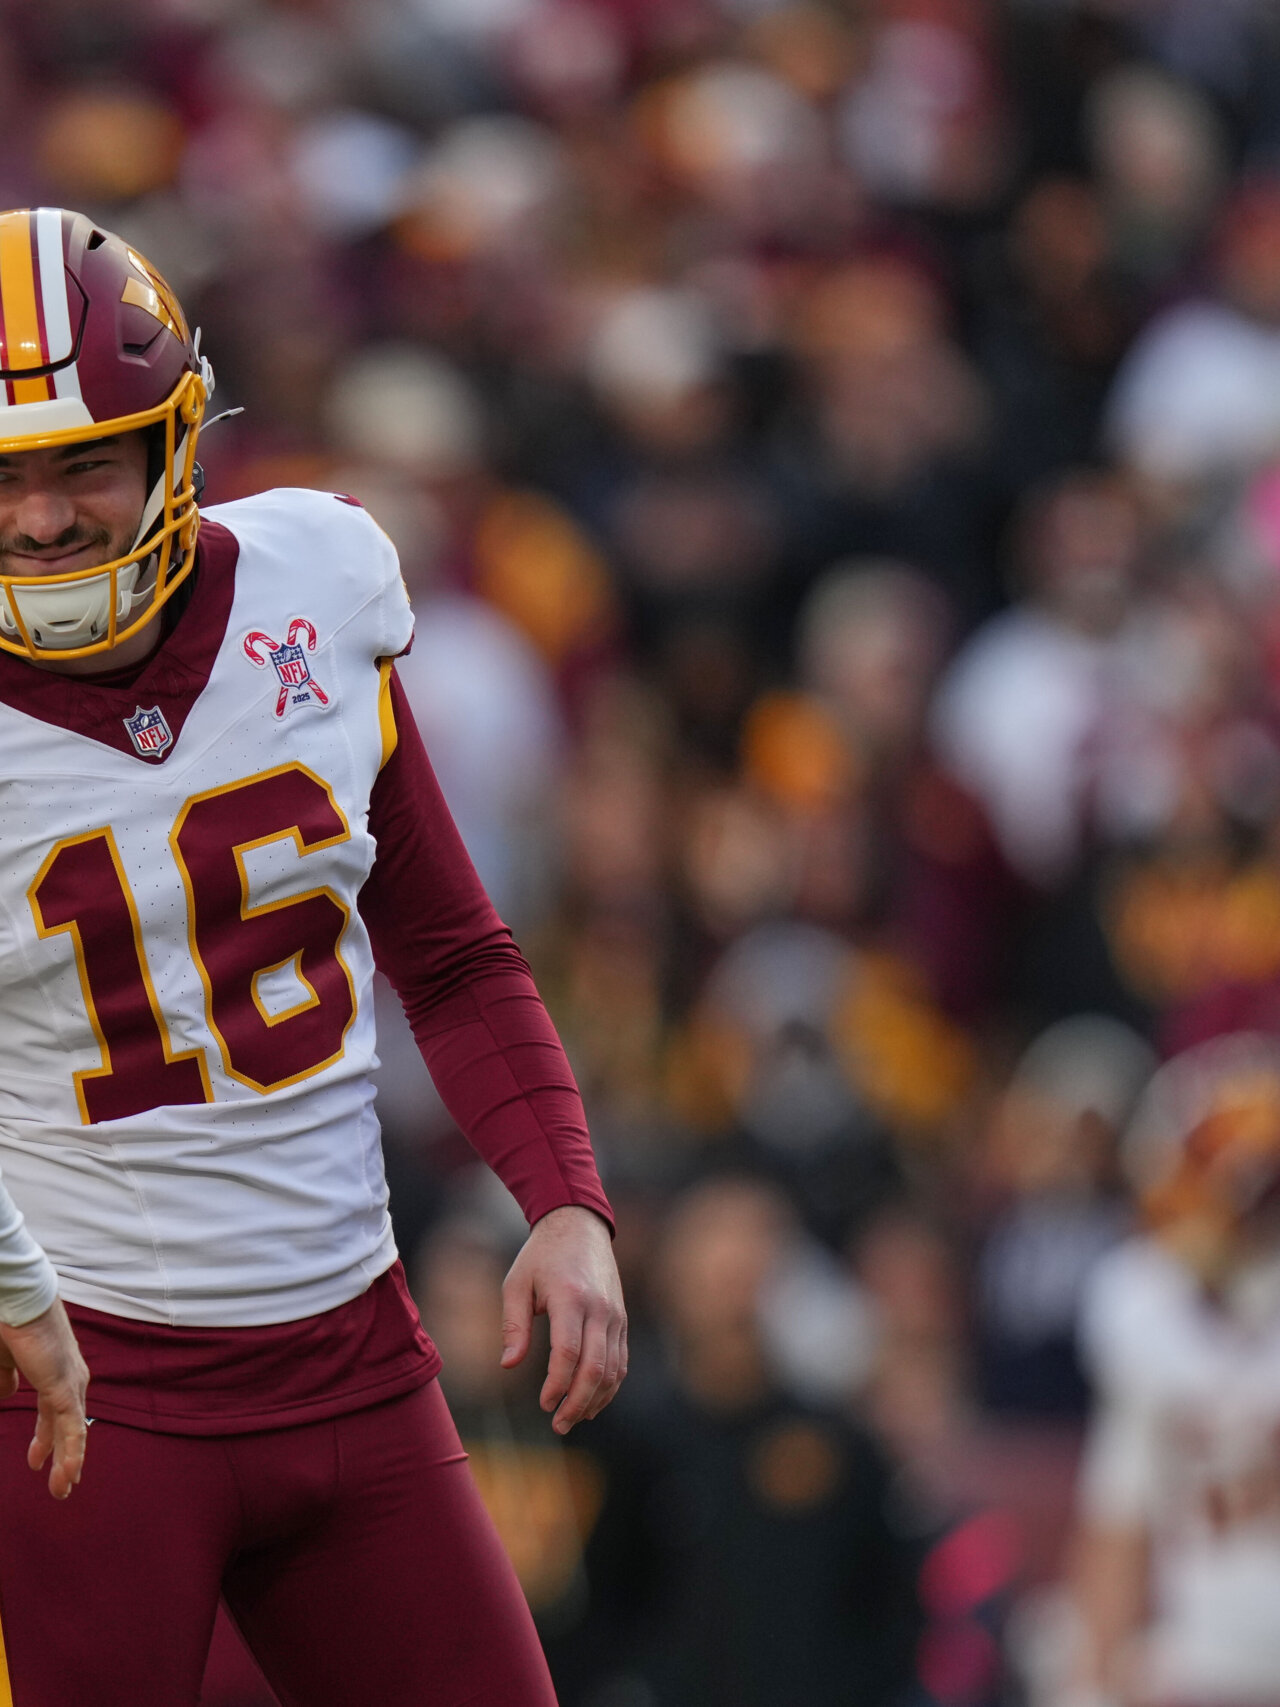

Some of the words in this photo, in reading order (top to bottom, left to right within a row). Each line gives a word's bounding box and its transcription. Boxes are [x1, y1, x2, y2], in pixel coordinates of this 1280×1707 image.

[278, 660, 308, 684] NFL
[291, 692, 311, 704] 2025
[136, 725, 167, 750] NFL
[26, 760, 358, 1127] 16
